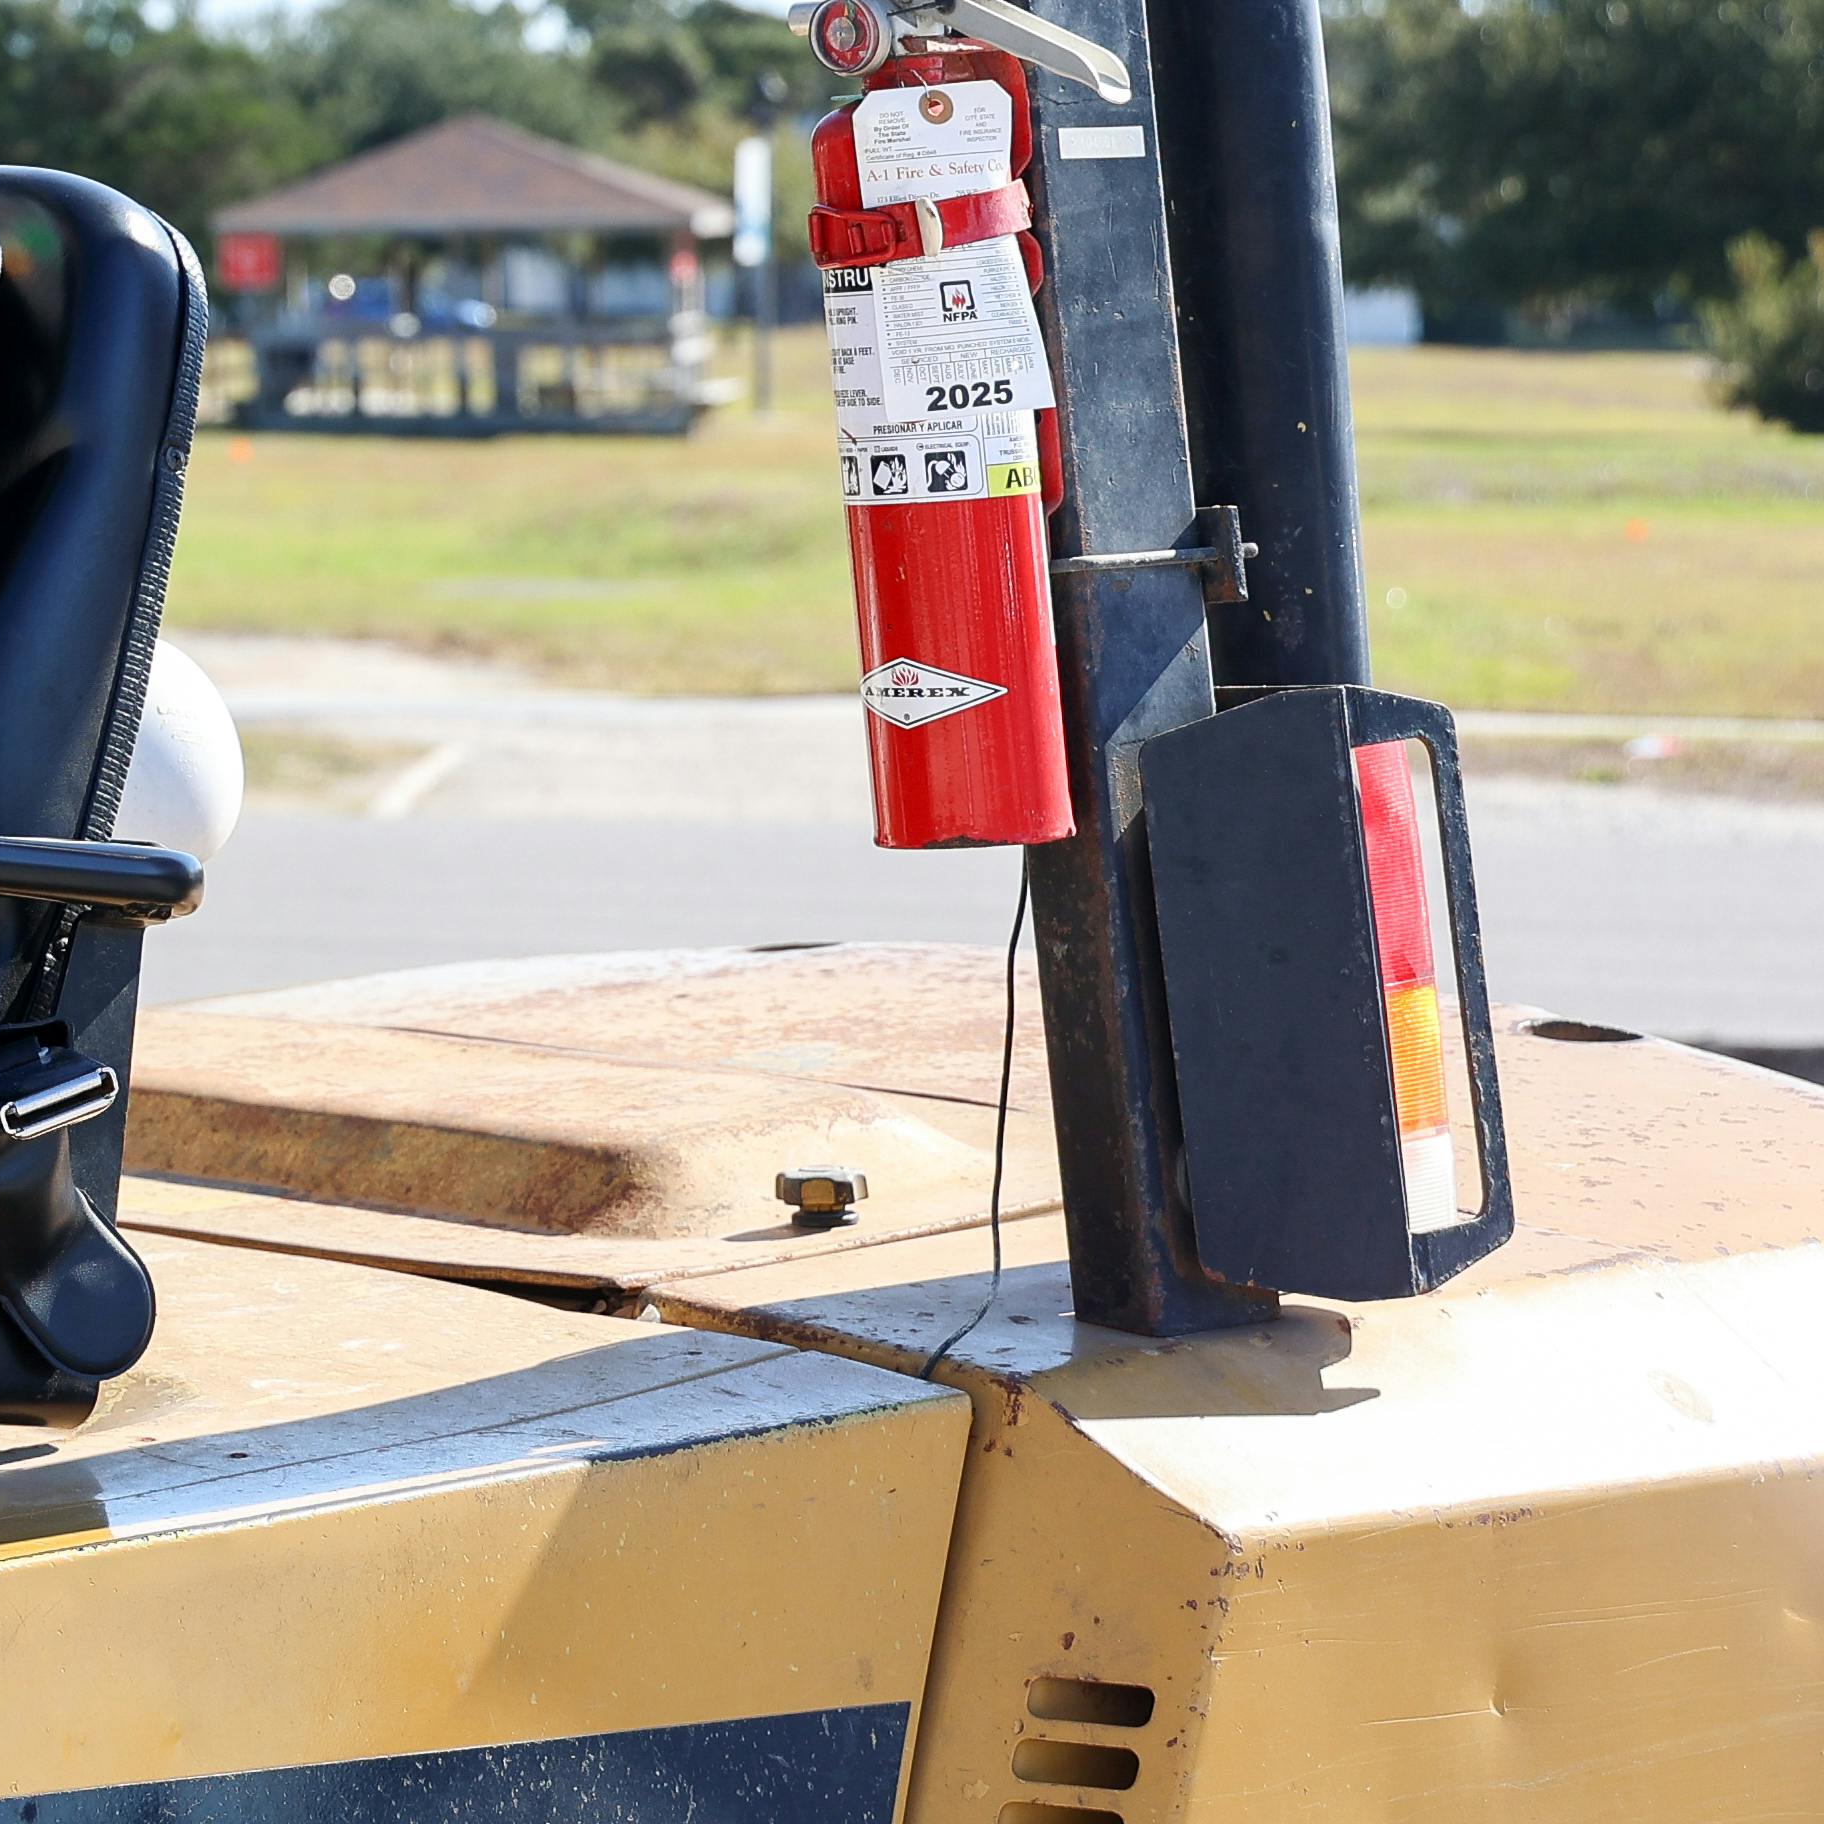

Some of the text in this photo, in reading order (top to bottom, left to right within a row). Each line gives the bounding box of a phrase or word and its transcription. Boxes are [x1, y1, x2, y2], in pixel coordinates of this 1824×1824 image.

[866, 169, 889, 182] A-1
[896, 166, 924, 180] Fire
[929, 163, 944, 176] &
[949, 160, 985, 175] Safety
[943, 311, 978, 323] NFPA
[859, 346, 875, 356] FEET.
[990, 345, 1032, 356] RECHARGED
[919, 366, 928, 381] OCT
[944, 363, 953, 379] AUG
[866, 397, 882, 406] SIDE.
[925, 378, 1014, 412] 2025
[873, 421, 963, 435] PRESIONAR Y APLICAR
[865, 686, 970, 698] AMEREX
